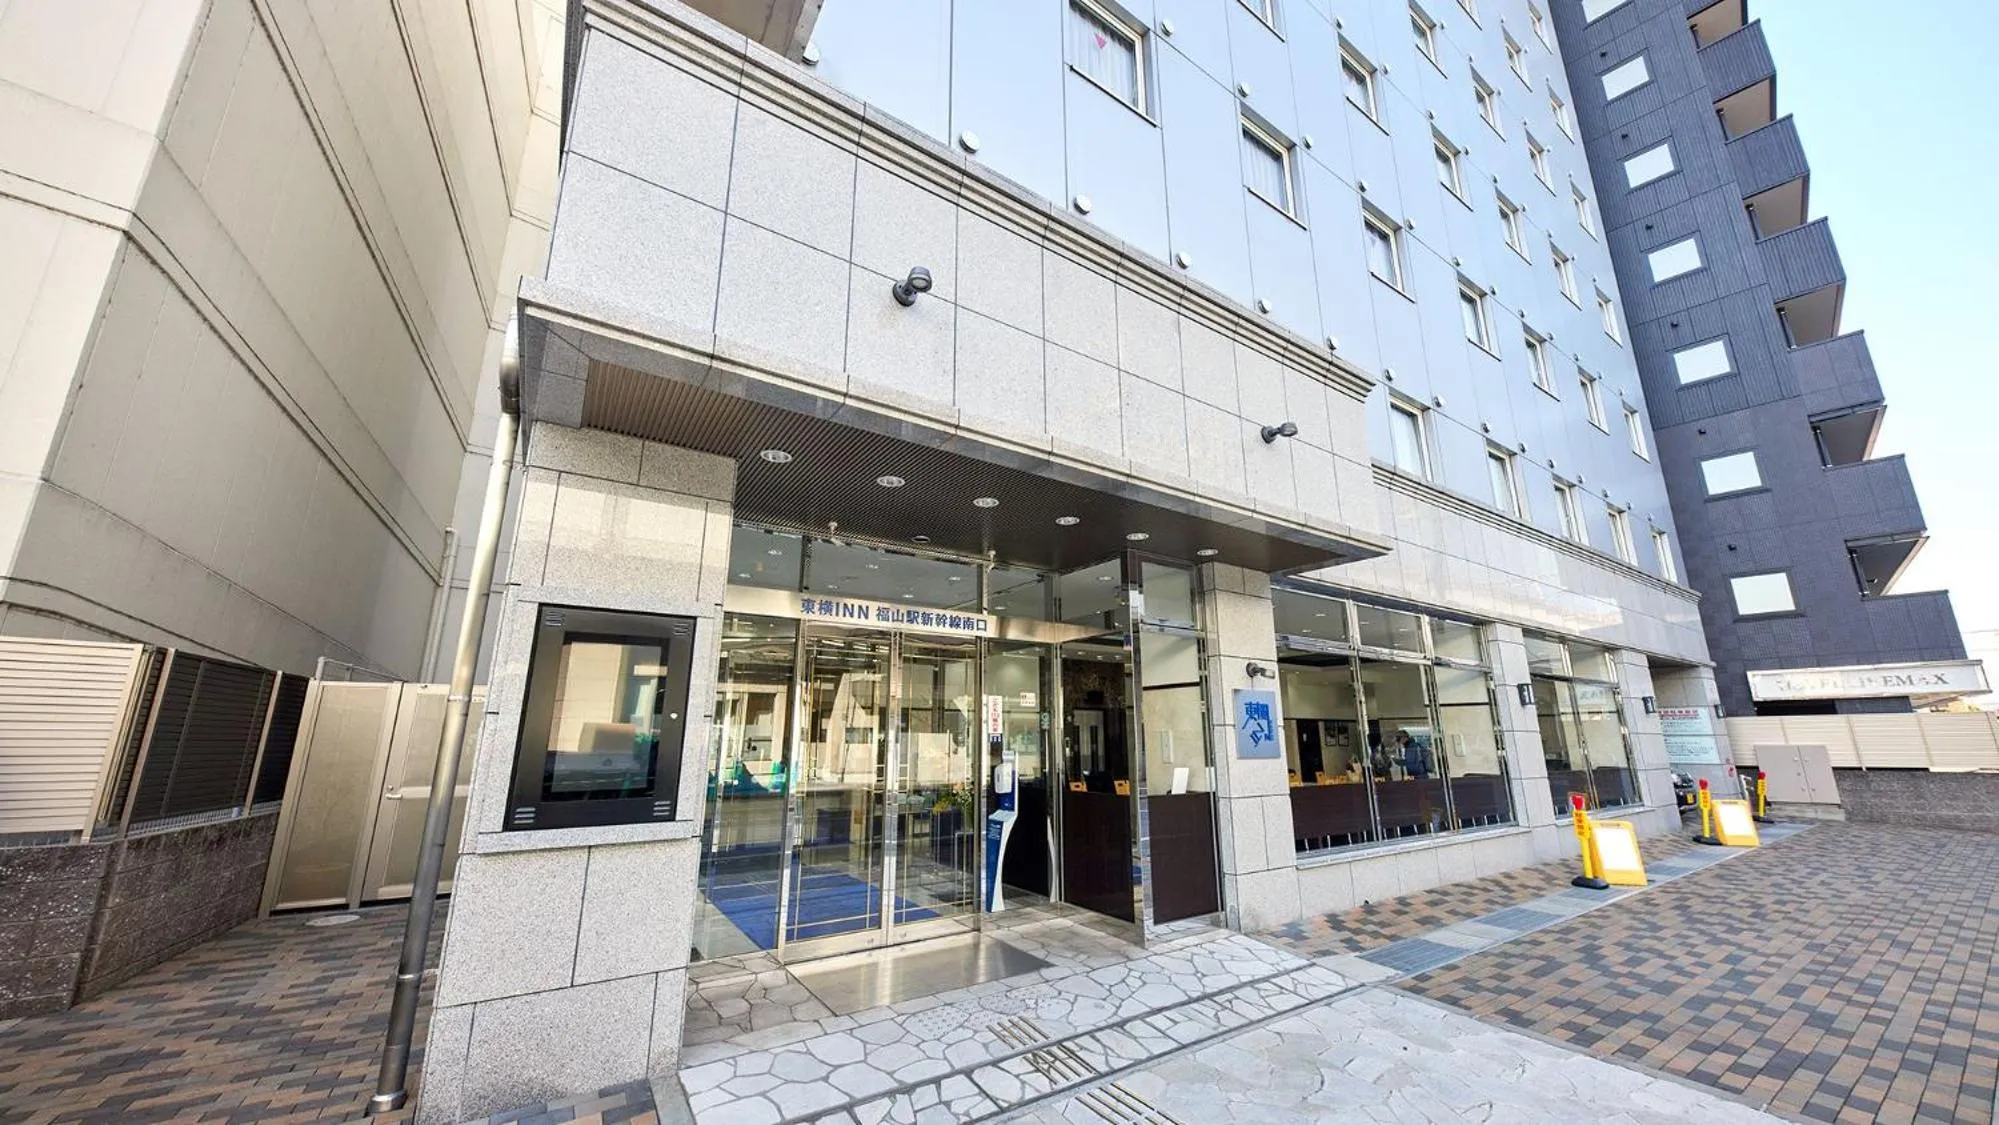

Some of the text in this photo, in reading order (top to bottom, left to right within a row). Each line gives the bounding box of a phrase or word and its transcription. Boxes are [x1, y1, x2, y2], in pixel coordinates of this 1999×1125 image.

[801, 598, 987, 632] 東横INN 福山駅新幹線南口
